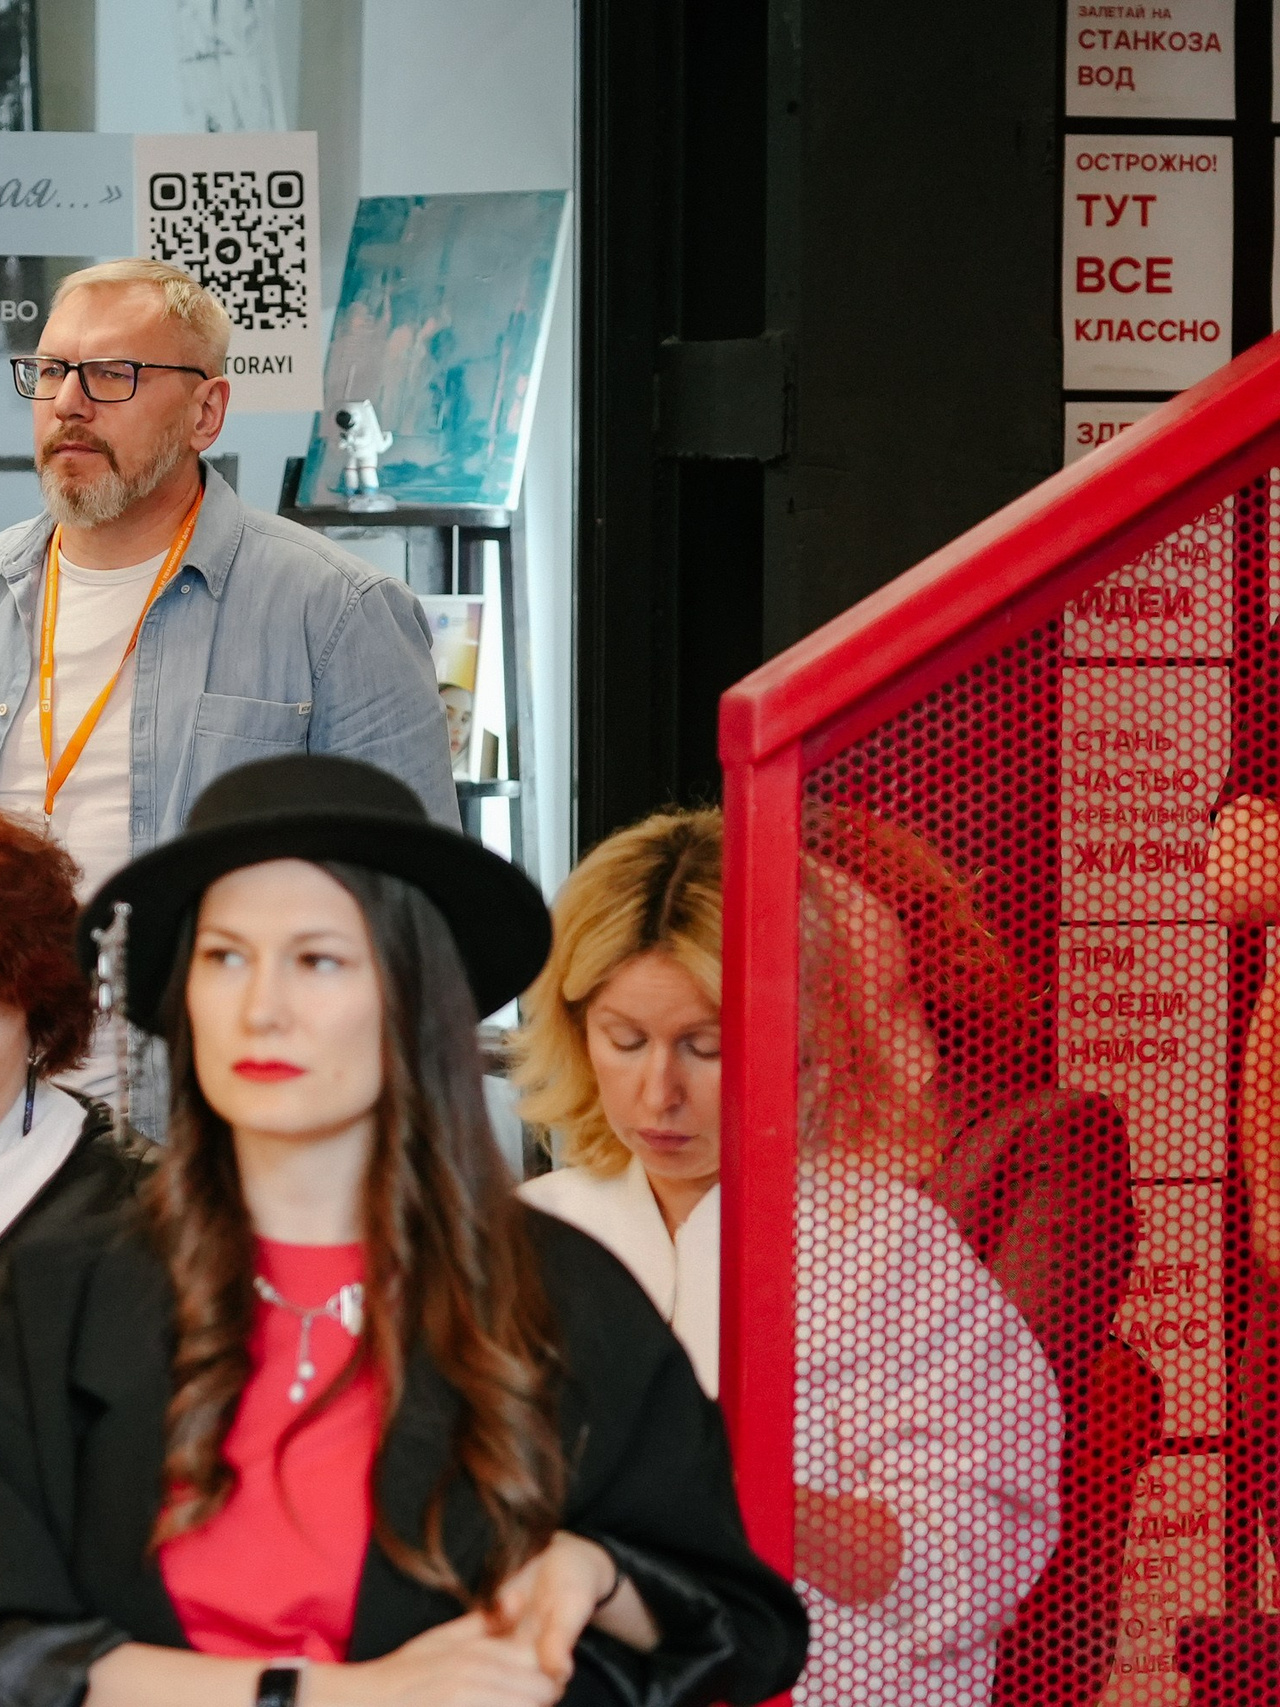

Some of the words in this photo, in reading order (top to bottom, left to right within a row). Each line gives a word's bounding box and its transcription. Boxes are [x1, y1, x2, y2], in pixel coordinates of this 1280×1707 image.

[1078, 5, 1145, 18] ЗАЛЕТАЙ
[1152, 8, 1171, 19] НА
[1078, 28, 1222, 52] СТАНКОЗА
[1078, 65, 1135, 91] ВОД
[1076, 153, 1217, 173] ОСТРОЖНО!
[1076, 194, 1157, 227] ТУТ
[1075, 257, 1173, 293] ВСЕ
[1075, 319, 1220, 342] КЛАССНО
[1074, 730, 1172, 750] СТАНЬ
[1073, 769, 1199, 792] ЧАСТЬЮ
[1072, 947, 1134, 971] ПРИ
[1071, 992, 1184, 1021] СОЕДИ
[1071, 1032, 1178, 1063] НЯЙСЯ
